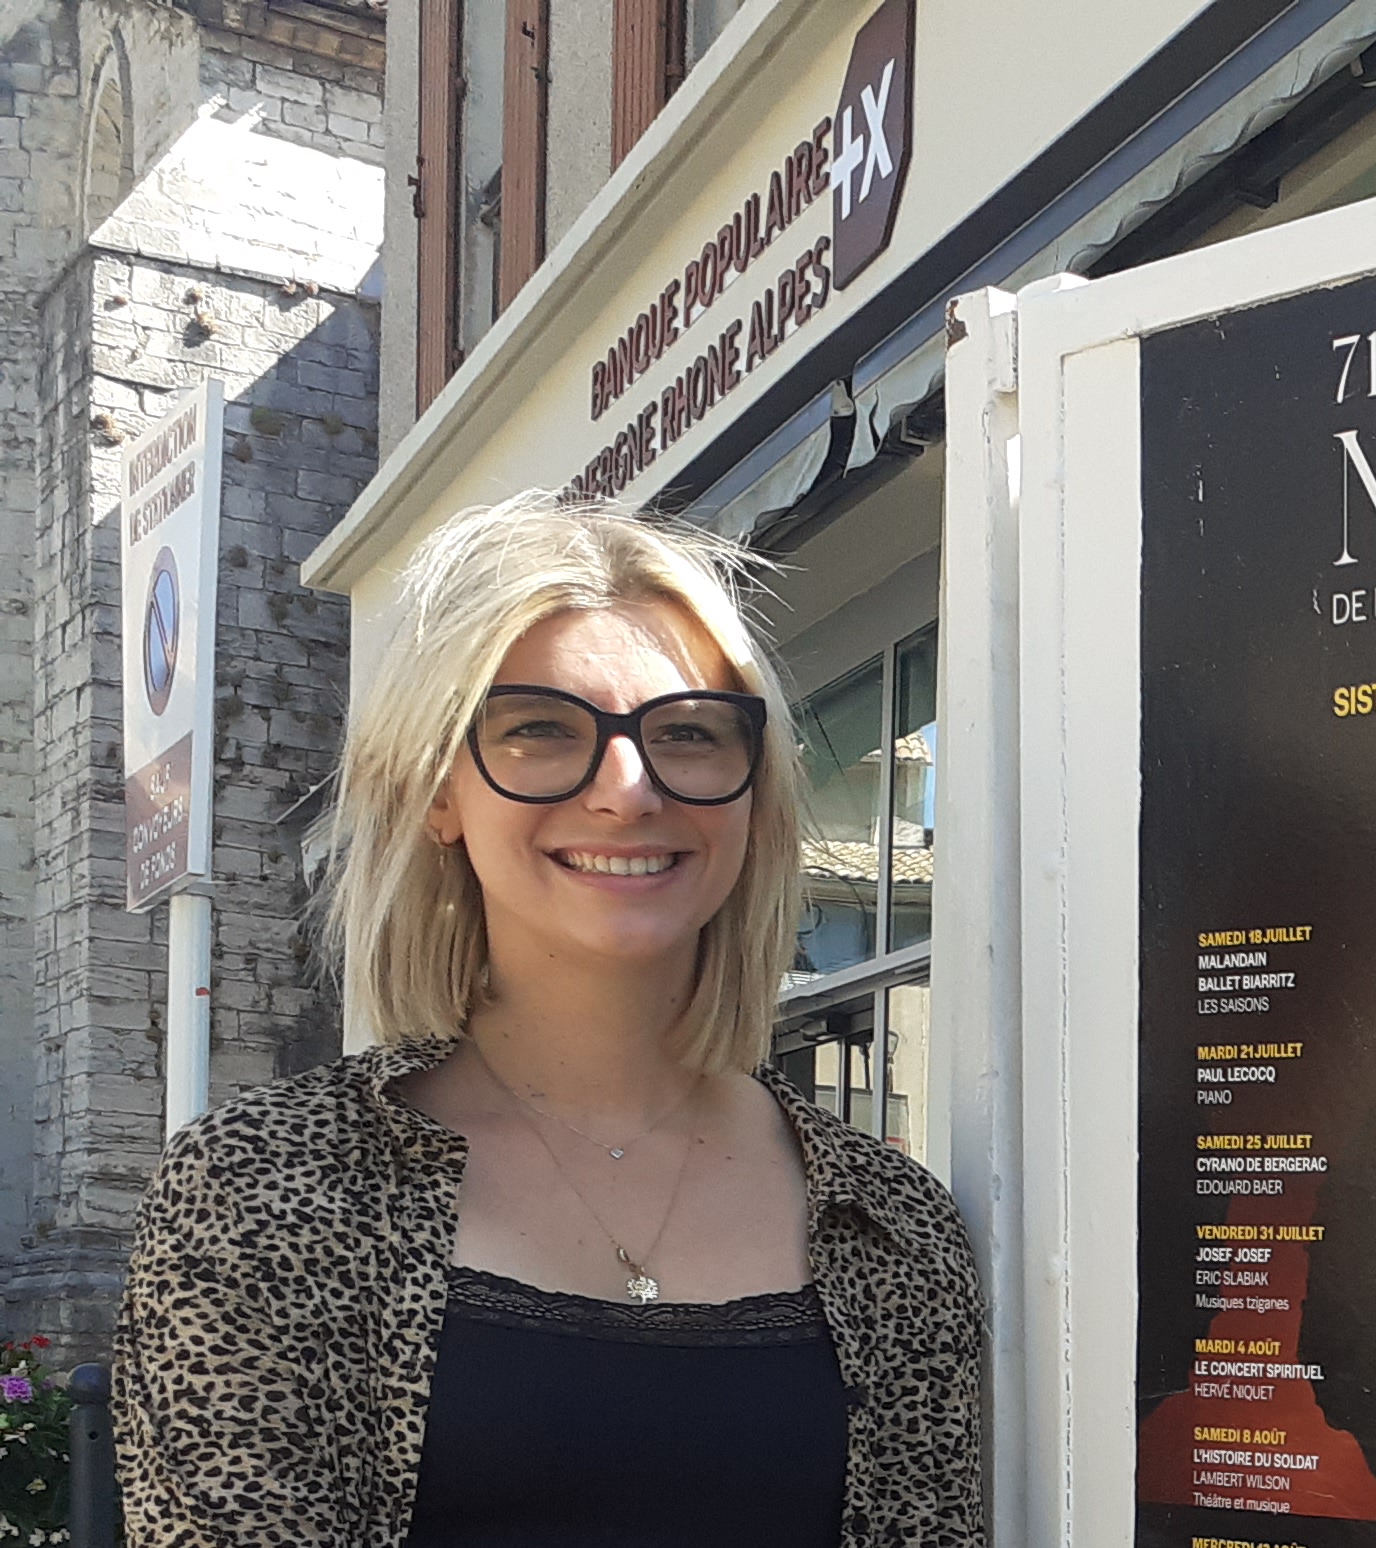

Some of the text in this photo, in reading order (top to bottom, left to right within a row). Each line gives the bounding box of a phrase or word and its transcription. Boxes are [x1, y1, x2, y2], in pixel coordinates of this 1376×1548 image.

[590, 117, 832, 421] BANQUE POPULAIRE
[660, 318, 742, 450] RHONE
[746, 236, 831, 372] ALPES
[1332, 590, 1366, 625] DE
[1198, 927, 1312, 947] SAMEDI 18 JUILLET
[1198, 952, 1267, 969] MALANDAIN
[1198, 973, 1295, 991] BALLET BIARRITZ
[1198, 997, 1270, 1014] LES SAISONS
[1197, 1043, 1303, 1060] MARDI 21 JUILLET
[1197, 1066, 1276, 1082] PAUL LECOCQ
[1197, 1090, 1232, 1104] PIANO
[1197, 1135, 1312, 1149] SAMEDI 25 JUILLET
[1197, 1157, 1327, 1172] CYRANO DE BERGERAC
[1196, 1180, 1283, 1194] EDOUARD BAER
[1196, 1225, 1324, 1240] VENDREDI 31 JUILLET
[1196, 1248, 1271, 1263] JOSEF JOSEF
[1196, 1270, 1268, 1286] ERIC SLABIAK
[1196, 1294, 1289, 1313] Musiques tziganes
[1195, 1338, 1281, 1355] MARDI 4 AOÛT
[1195, 1361, 1324, 1379] LE CONCERT SPIRITUEL
[1195, 1379, 1275, 1401] HERVÉ NIQUET
[1194, 1427, 1287, 1445] SAMEDI 8 AOÛT
[1193, 1449, 1319, 1470] L'HISTOIRE DU SOLDAT
[1193, 1471, 1290, 1490] LAMBERT WILSON
[1193, 1493, 1290, 1514] Théâtre et musique
